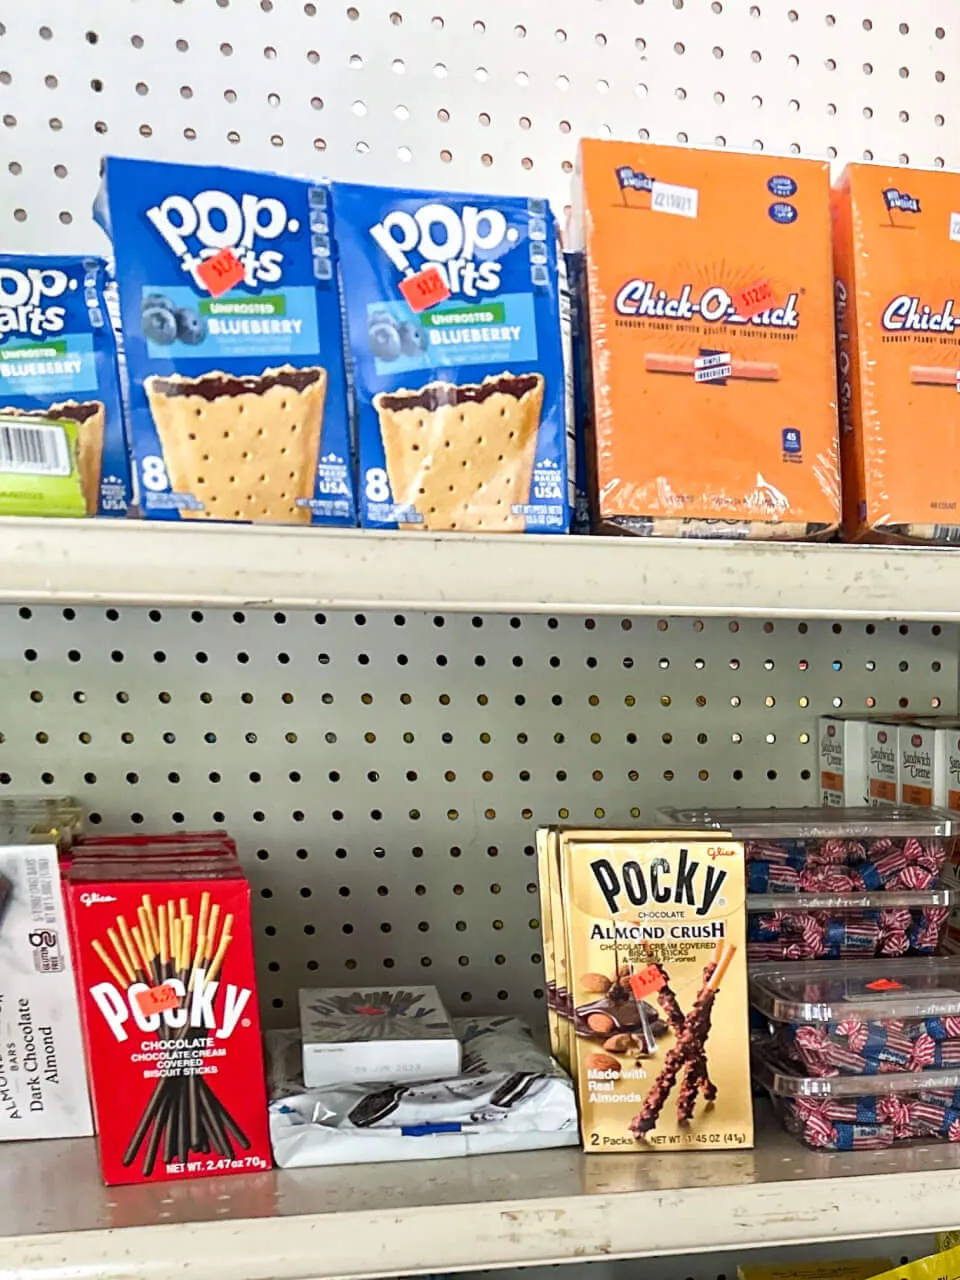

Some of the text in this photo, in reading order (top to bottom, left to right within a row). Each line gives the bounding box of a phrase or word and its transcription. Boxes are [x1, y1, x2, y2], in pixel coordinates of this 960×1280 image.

[208, 318, 302, 335] BLUEBERRY
[430, 327, 521, 346] BLUEBERRY
[142, 456, 169, 491] 8
[320, 481, 349, 494] USA
[365, 468, 389, 502] 8
[534, 487, 562, 499] USA
[638, 910, 685, 920] CHOCOLATE
[590, 921, 726, 941] ALMOND CRUSH
[599, 942, 717, 952] CHOCOLATE COVERED
[141, 1036, 216, 1051] CHOCOLATE
[22, 998, 44, 1113] Dark Chocolate
[44, 1024, 60, 1085] Almond
[131, 1047, 227, 1063] CHOCOLATE CREAM
[156, 1058, 204, 1070] COVERED
[143, 1065, 219, 1079] BISCUIT STICKS
[587, 1068, 647, 1081] Made with
[587, 1080, 615, 1093] Real
[589, 1092, 642, 1104] Almonds
[590, 1133, 634, 1148] 2 Packs
[650, 1135, 668, 1146] NET
[166, 1162, 186, 1175] NET
